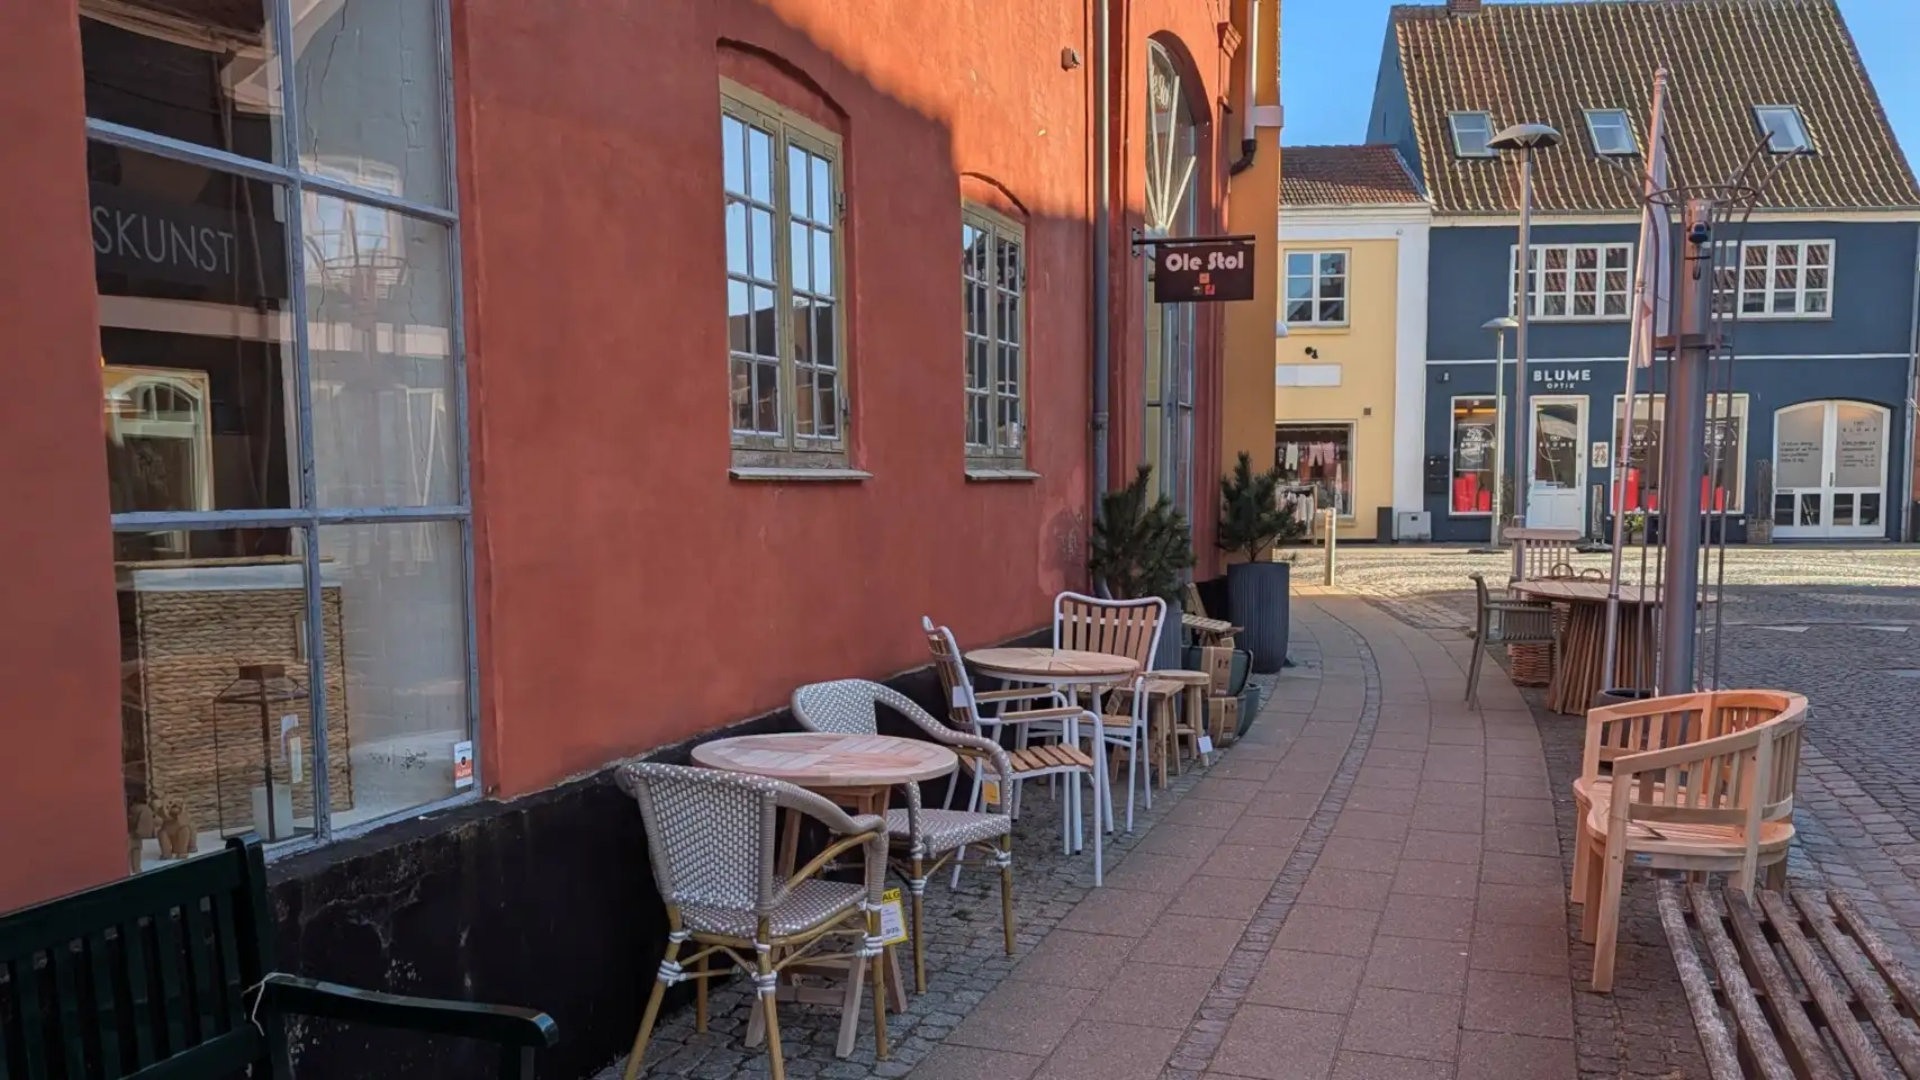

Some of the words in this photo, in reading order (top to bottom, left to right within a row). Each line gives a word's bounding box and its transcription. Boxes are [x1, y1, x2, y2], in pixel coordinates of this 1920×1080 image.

[92, 206, 234, 274] SKUNST
[1165, 252, 1202, 272] Ole
[1208, 250, 1244, 271] Stol
[1533, 369, 1591, 382] BLUME
[1546, 382, 1576, 390] OPTIK
